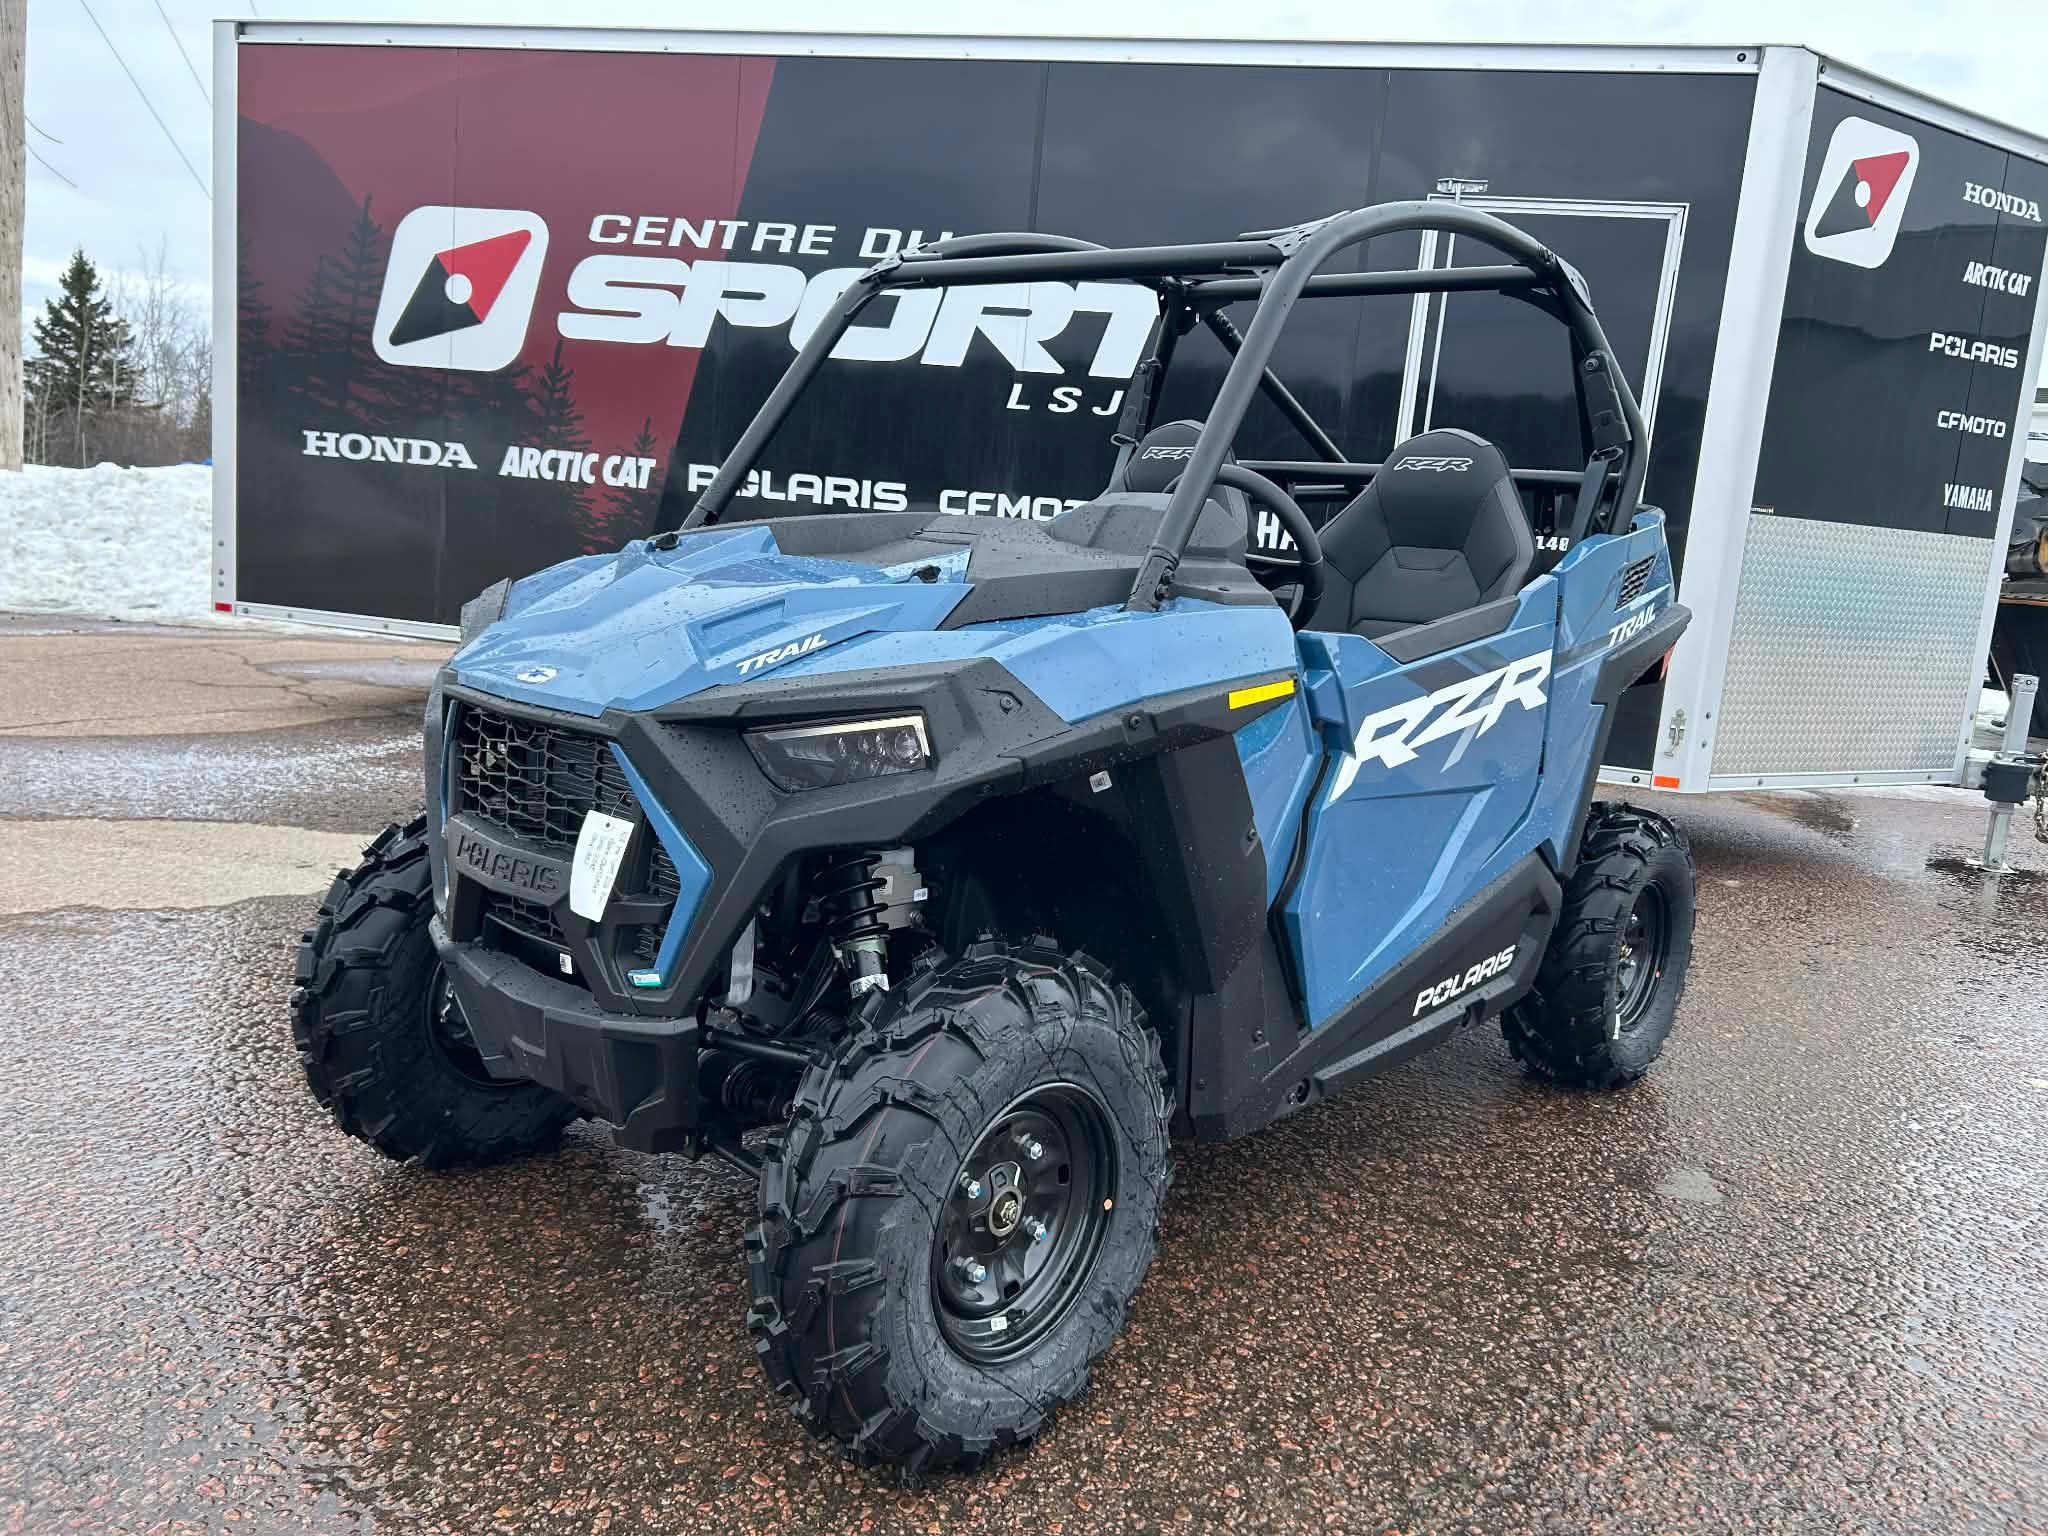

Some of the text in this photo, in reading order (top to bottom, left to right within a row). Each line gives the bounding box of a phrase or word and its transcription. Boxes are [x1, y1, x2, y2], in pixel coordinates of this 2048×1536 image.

[1963, 182, 2042, 223] HONDA
[588, 214, 837, 255] CENTRE
[1962, 260, 2032, 297] ARCTIC CAT
[557, 253, 1160, 379] SPORT
[1929, 331, 2019, 369] POLARIS
[1937, 410, 2007, 438] CFMOTO
[302, 429, 478, 470] HONDA
[498, 445, 657, 490] ARCTIC CAT
[1393, 456, 1474, 472] RZR
[1943, 483, 1993, 512] YAMAHA
[1608, 602, 1656, 649] TRAIL
[735, 633, 828, 675] TRAIL
[1329, 647, 1553, 802] RZR
[456, 834, 560, 892] POLARIS
[1412, 944, 1517, 1017] POLARIS
